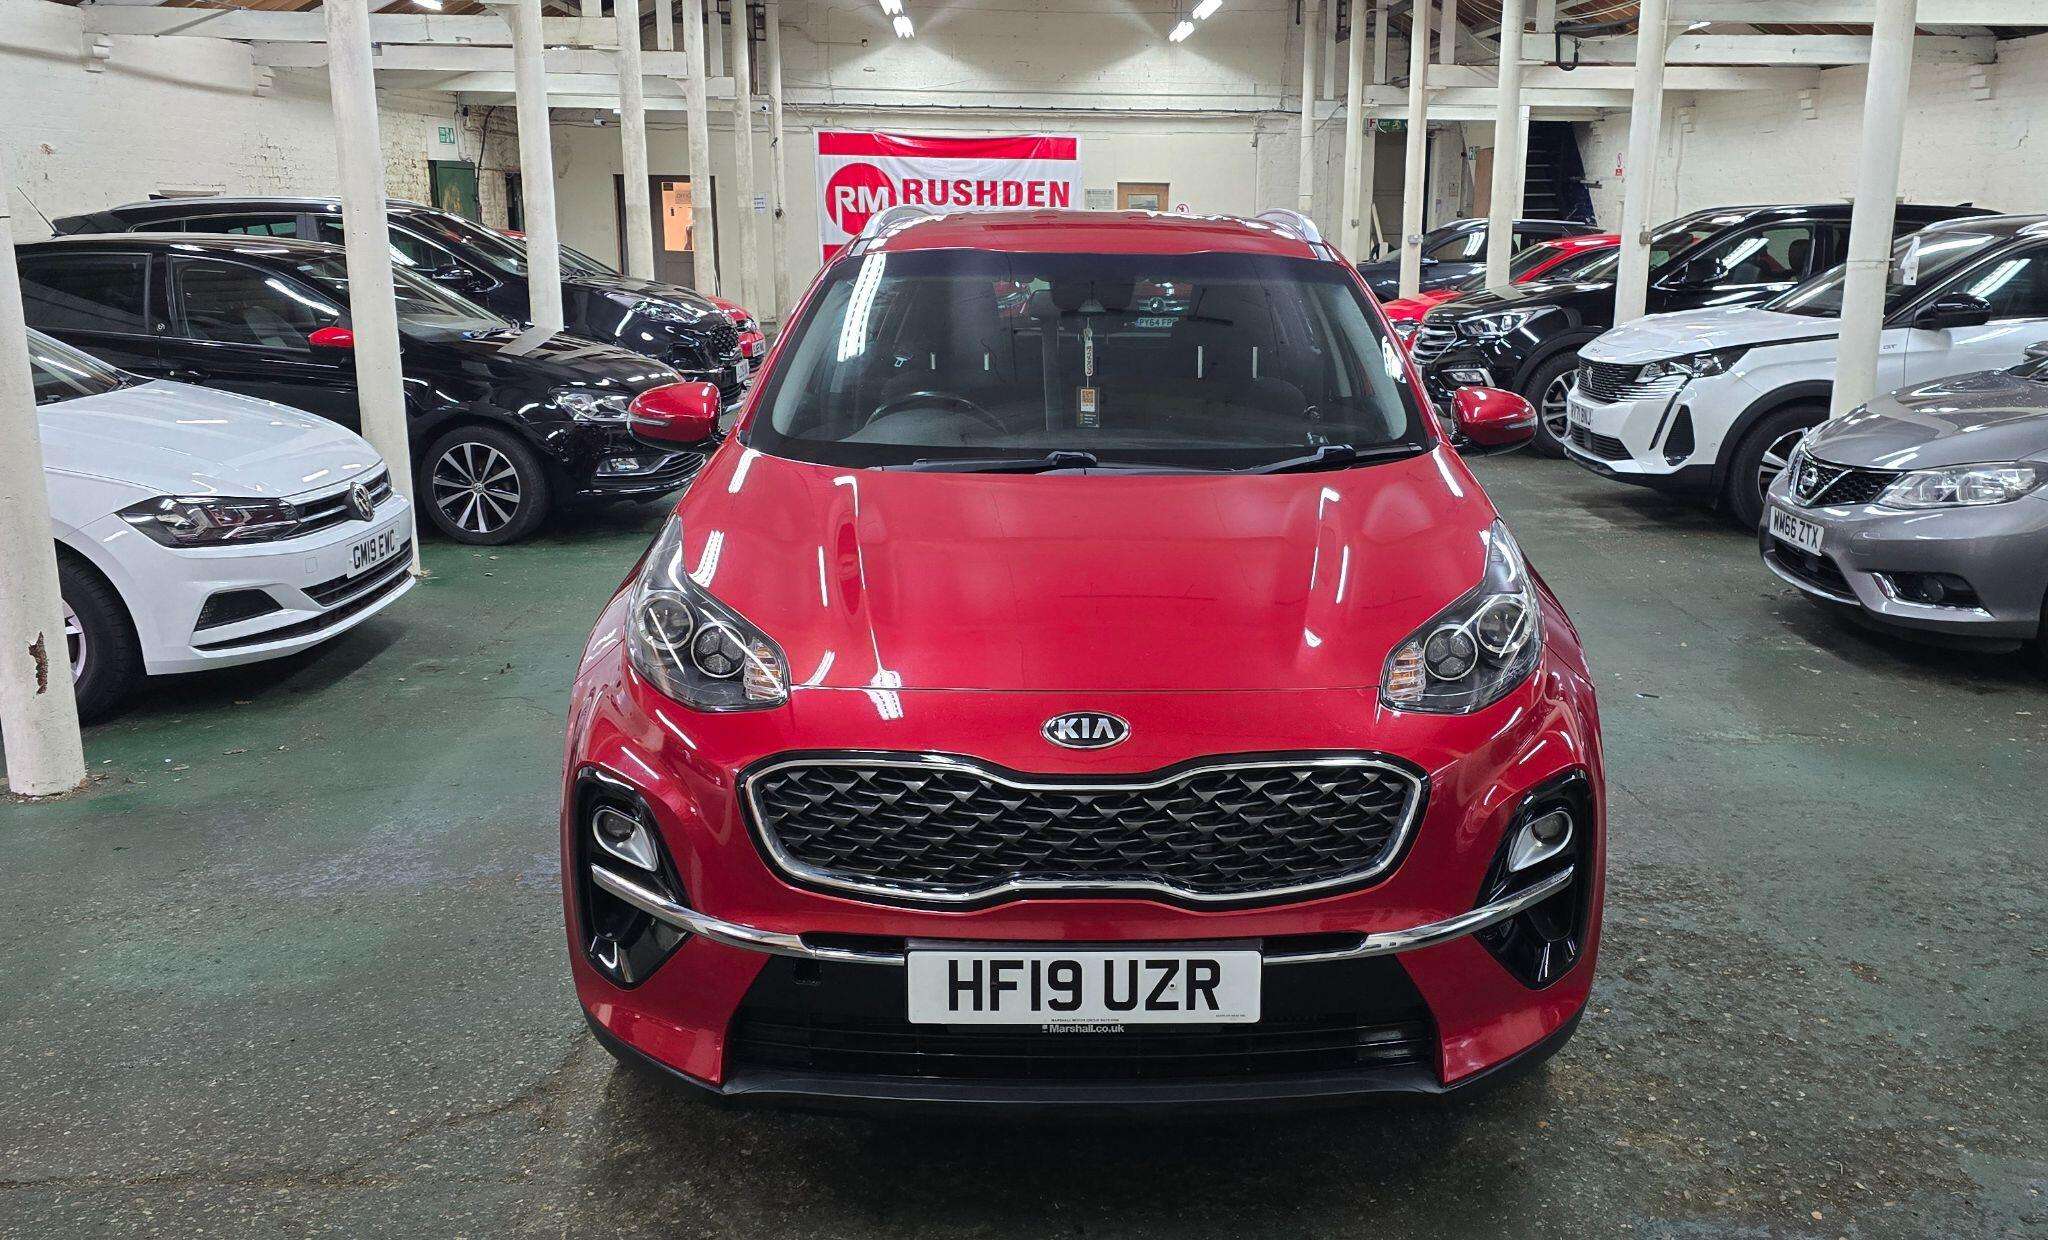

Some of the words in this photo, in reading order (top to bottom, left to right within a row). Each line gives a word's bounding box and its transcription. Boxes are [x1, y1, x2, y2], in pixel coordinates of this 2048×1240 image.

[834, 185, 889, 228] RM
[902, 178, 1070, 208] RUSHDEN
[353, 538, 377, 569] GM19
[378, 529, 396, 557] EWC
[1773, 509, 1797, 539] WM66
[1798, 520, 1819, 549] ZTX
[1057, 717, 1116, 740] KIA
[948, 960, 1083, 1011] HF19
[1104, 960, 1221, 1011] UZR
[1049, 1024, 1125, 1033] Marshall.co.uk
